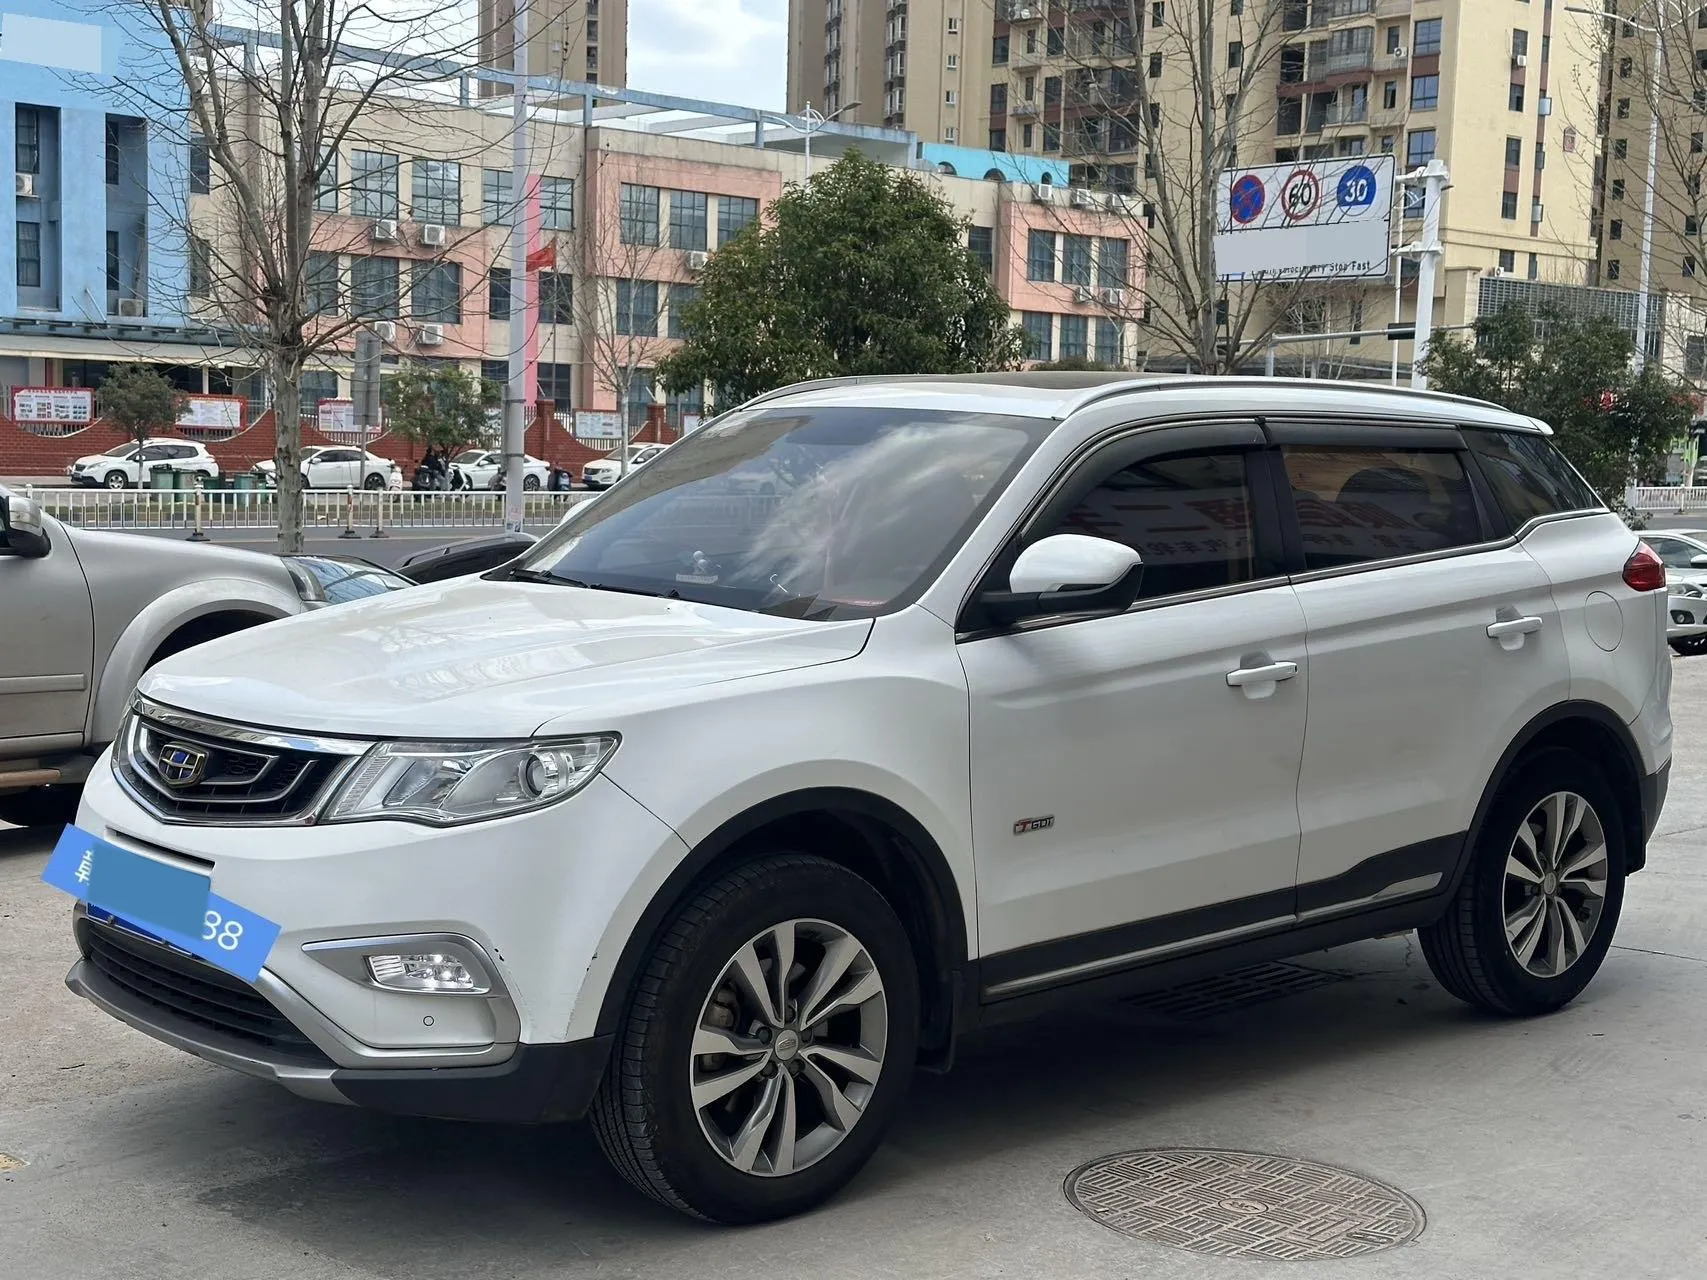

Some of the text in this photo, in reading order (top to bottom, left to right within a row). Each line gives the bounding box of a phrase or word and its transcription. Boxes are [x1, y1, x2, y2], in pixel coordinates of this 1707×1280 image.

[1345, 179, 1368, 202] 30
[1330, 262, 1348, 272] Stop
[1351, 261, 1370, 271] Fast
